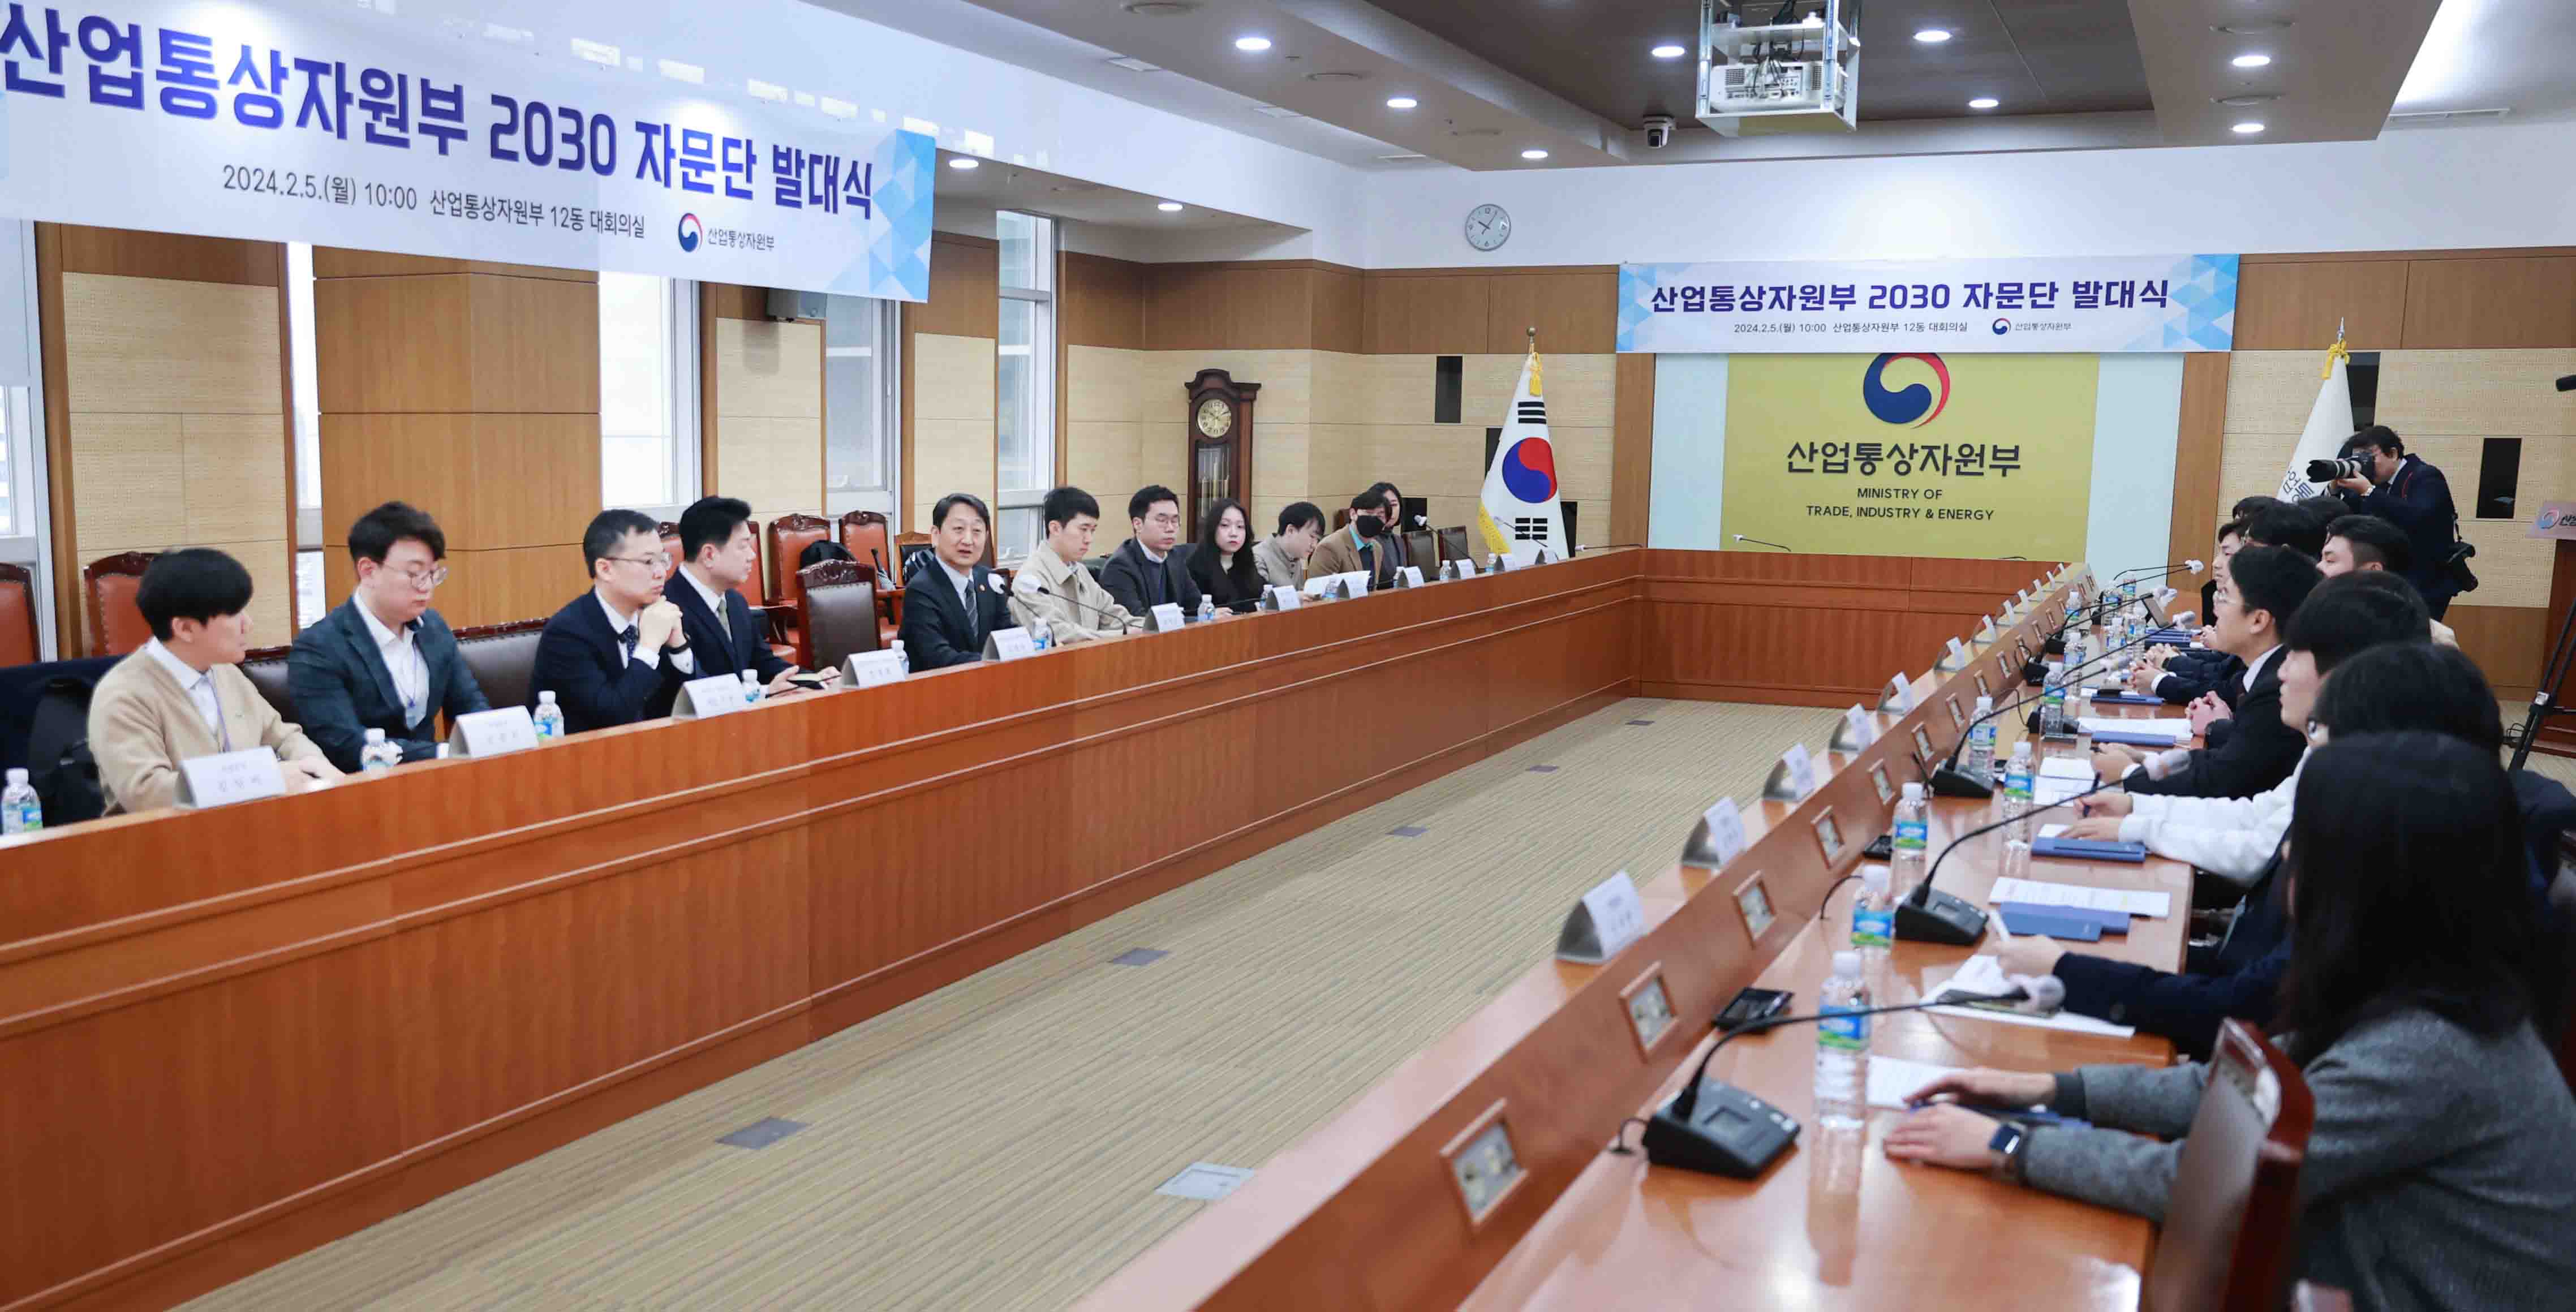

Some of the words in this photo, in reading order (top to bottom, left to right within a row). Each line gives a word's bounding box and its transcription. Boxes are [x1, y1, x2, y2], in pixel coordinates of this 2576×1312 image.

[0, 2, 468, 156] 산업통상자원부
[490, 93, 617, 177] 2030
[635, 121, 757, 201] 자문단
[772, 144, 873, 220] 발대식
[223, 164, 356, 205] 2024.2.5.(월)
[364, 182, 417, 210] 10:00
[430, 190, 545, 226] 산업통상자원부
[550, 206, 584, 231] 12동
[590, 210, 645, 239] 대회의실
[707, 227, 775, 251] 산업통상자원부
[1652, 284, 1856, 312] 산업통상자원부
[1869, 283, 1950, 309] 2030
[1963, 281, 2059, 309] 자문단
[2072, 279, 2168, 309] 발대식
[1733, 322, 1795, 333] 2024.2.5.(월)
[1800, 323, 1827, 333] 10:00
[1833, 322, 1899, 333] 산업통상자원부
[1904, 322, 1925, 333] 12동
[1928, 321, 1968, 333] 대회의실
[2015, 322, 2072, 332] 산업통상자원부
[1787, 442, 2020, 477] 산업통상자원부
[1856, 488, 1919, 498] MINISTRY
[1924, 488, 1943, 500] OF
[1806, 505, 1852, 518] TRADE,
[1856, 506, 1920, 518] INDUSTRY
[1925, 509, 1934, 519] &
[1938, 509, 1994, 520] ENERGY
